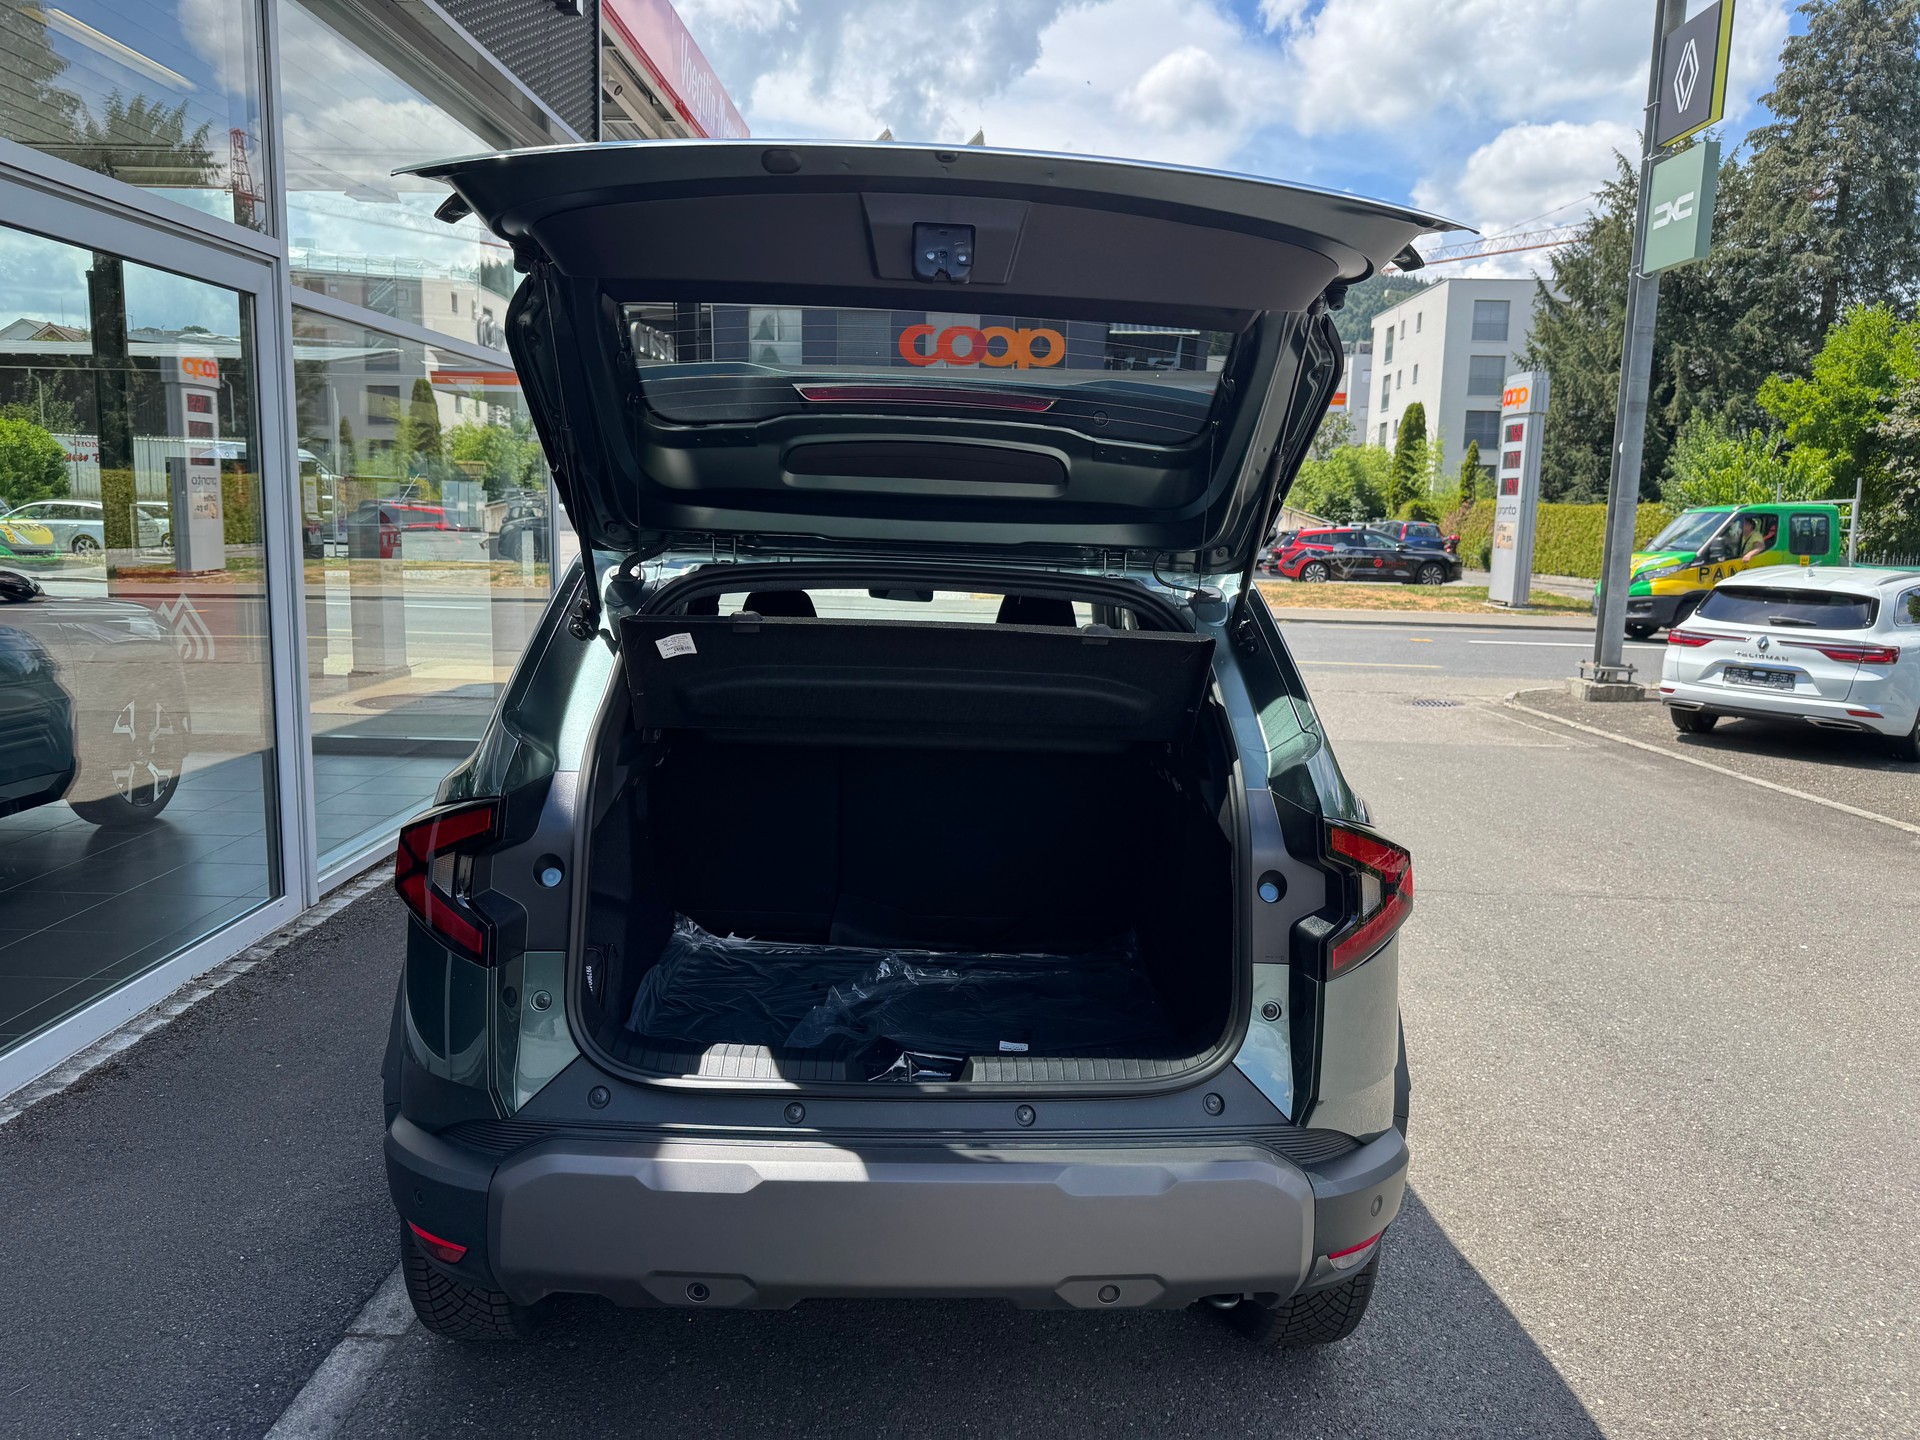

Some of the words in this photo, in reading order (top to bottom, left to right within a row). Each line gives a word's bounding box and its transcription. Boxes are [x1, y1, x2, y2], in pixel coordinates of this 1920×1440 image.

[898, 323, 1066, 371] coop
[1503, 387, 1529, 409] coop
[1736, 651, 1789, 662] TALISMAN
